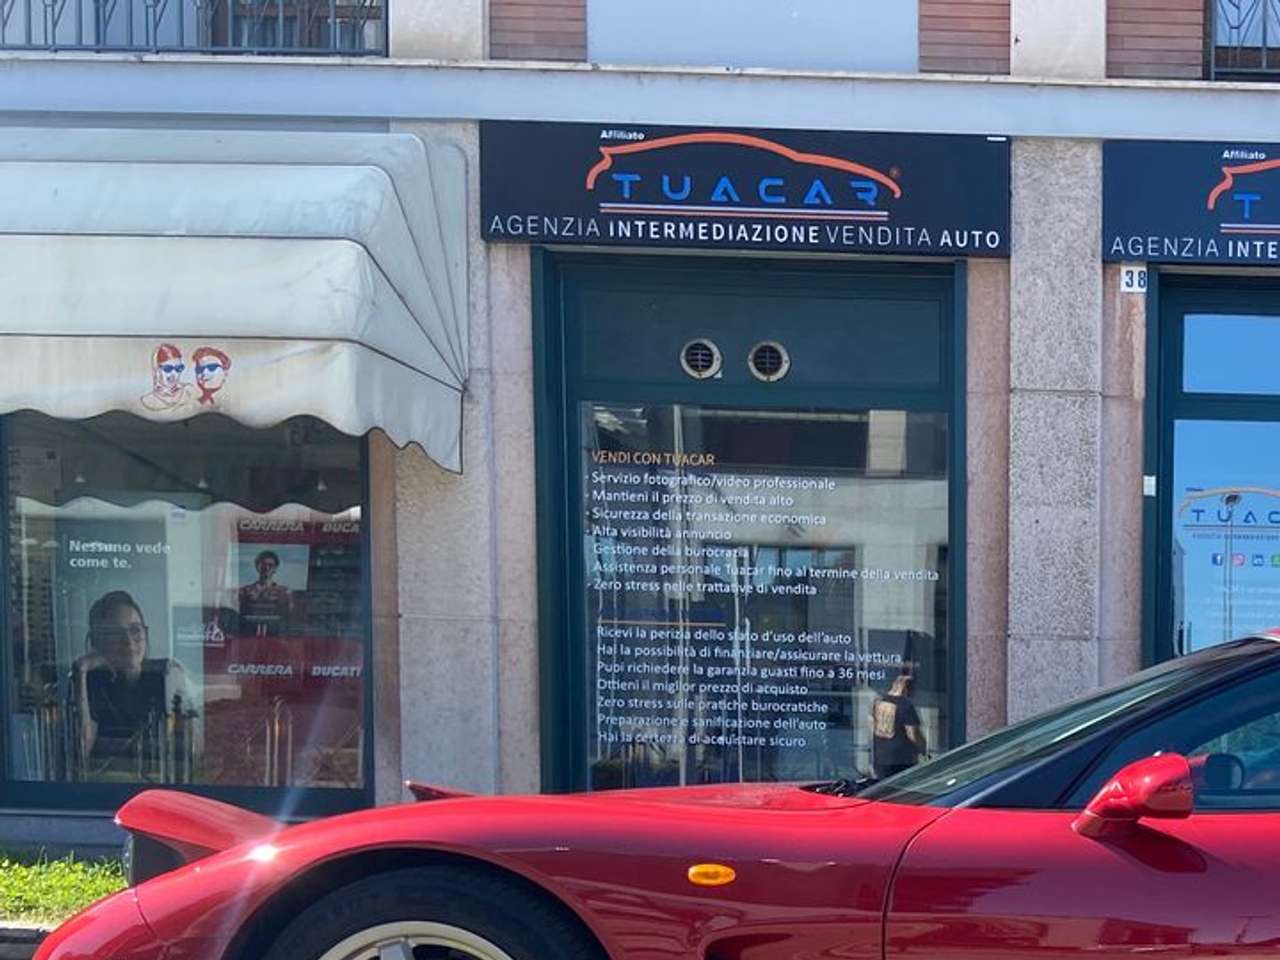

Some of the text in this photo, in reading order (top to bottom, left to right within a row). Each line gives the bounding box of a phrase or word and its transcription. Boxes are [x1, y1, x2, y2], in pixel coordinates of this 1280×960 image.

[600, 130, 645, 140] Affiliato
[1223, 149, 1267, 160] Affiliato
[612, 173, 878, 206] TUACAR
[489, 215, 1000, 248] AGENZIA INTERMEDIAZIONE VENDITA AUTO
[1110, 236, 1220, 258] AGENZIA
[1125, 270, 1146, 289] 38
[591, 451, 715, 466] VENDI CON TUACAR
[592, 471, 836, 492] Servizio fotografico/video professionale
[592, 490, 794, 506] Mantieni il prezzo di vendita alto
[239, 519, 304, 531] CARRERA
[592, 508, 827, 526] Sicurezza della transazione economica
[592, 525, 732, 541] Alta visibilità annuncio
[69, 540, 171, 554] Nessuno vede
[593, 543, 749, 558] Gestione della burocrazia
[69, 557, 132, 569] come te.
[593, 561, 657, 575] Assistenza
[660, 563, 721, 577] personale
[768, 564, 793, 577] fino
[795, 565, 806, 577] al
[809, 567, 859, 579] termine
[860, 568, 890, 580] della
[893, 569, 939, 581] vendita
[593, 578, 818, 596] Zero stress nelle trattative di vendita
[597, 625, 632, 639] Ricevi
[636, 627, 647, 639] la
[650, 628, 691, 644] perizia
[694, 629, 724, 641] dello
[597, 643, 617, 656] Hai
[620, 644, 631, 656] la
[634, 644, 696, 661] possibilità
[699, 646, 711, 658] di
[844, 650, 854, 662] la
[227, 663, 362, 677] CARRERA DUCATI
[627, 662, 689, 675] richiedere
[693, 663, 703, 676] la
[707, 665, 757, 679] garanzia
[760, 667, 797, 679] guasti
[800, 666, 824, 679] fino
[827, 670, 835, 679] a
[838, 667, 853, 679] 36
[856, 669, 885, 681] mesi
[597, 679, 808, 697] Ottieni il miglior prezzo di acquisto
[597, 696, 829, 714] Zero stress sulle pratiche burocratiche
[597, 713, 680, 728] Preparazione
[692, 715, 771, 729] sanificazione
[621, 731, 632, 743] la
[688, 732, 700, 744] di
[769, 735, 807, 747] sicuro
